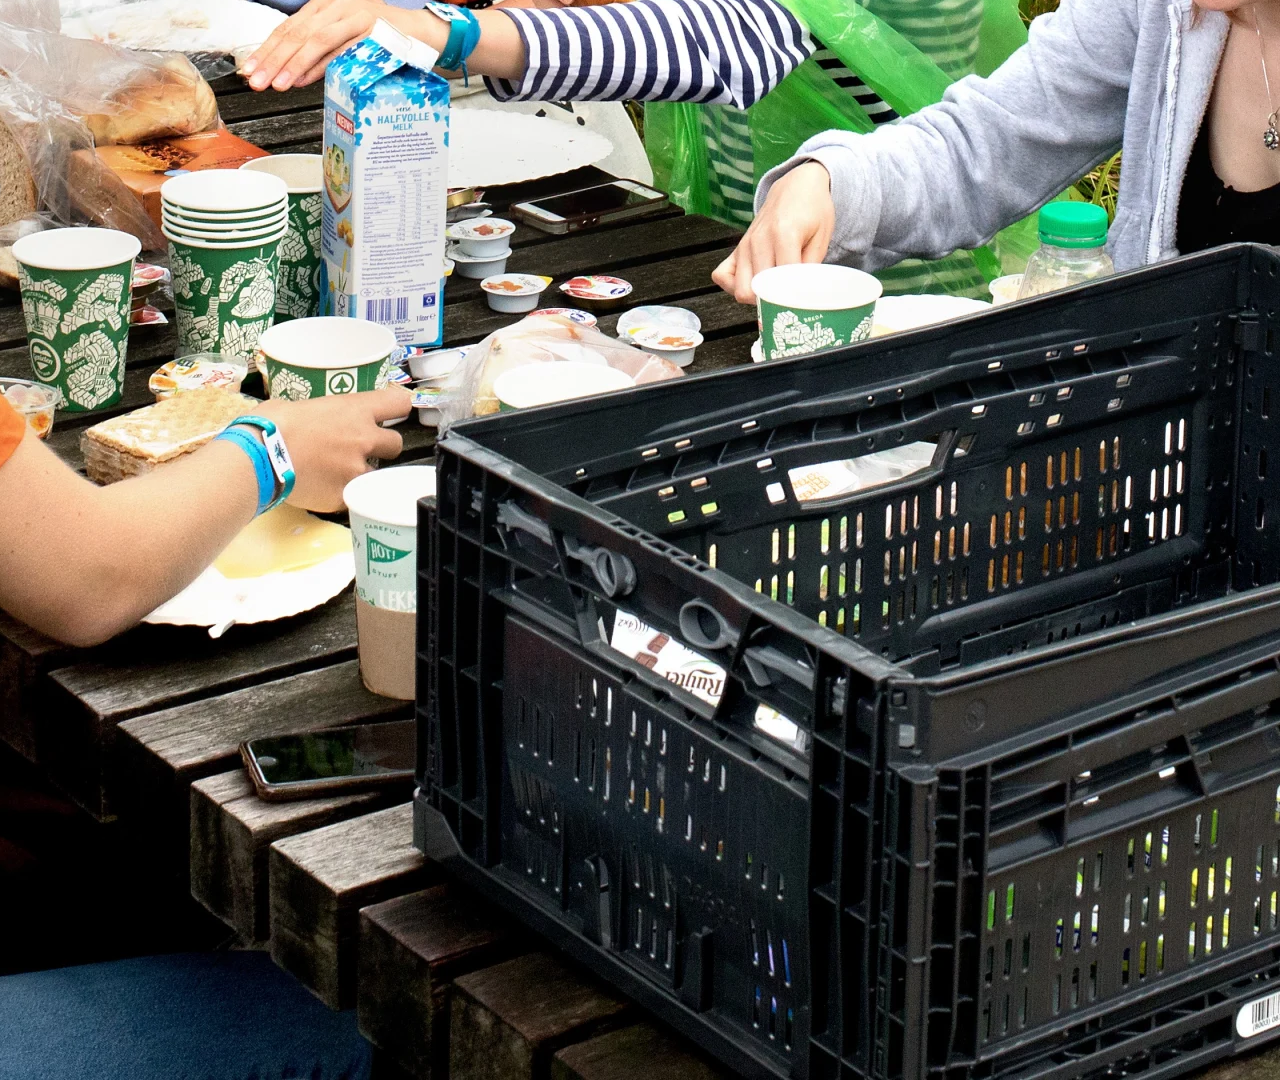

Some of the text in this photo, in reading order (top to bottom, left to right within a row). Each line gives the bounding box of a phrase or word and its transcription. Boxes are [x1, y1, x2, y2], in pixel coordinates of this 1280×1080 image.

[377, 112, 430, 125] HALFVOLLE
[392, 123, 413, 132] MELK
[803, 313, 824, 323] BREDA
[364, 523, 401, 537] CAREFUL
[370, 542, 396, 560] HOT!
[371, 568, 399, 579] STUFF
[379, 588, 417, 613] LEKK
